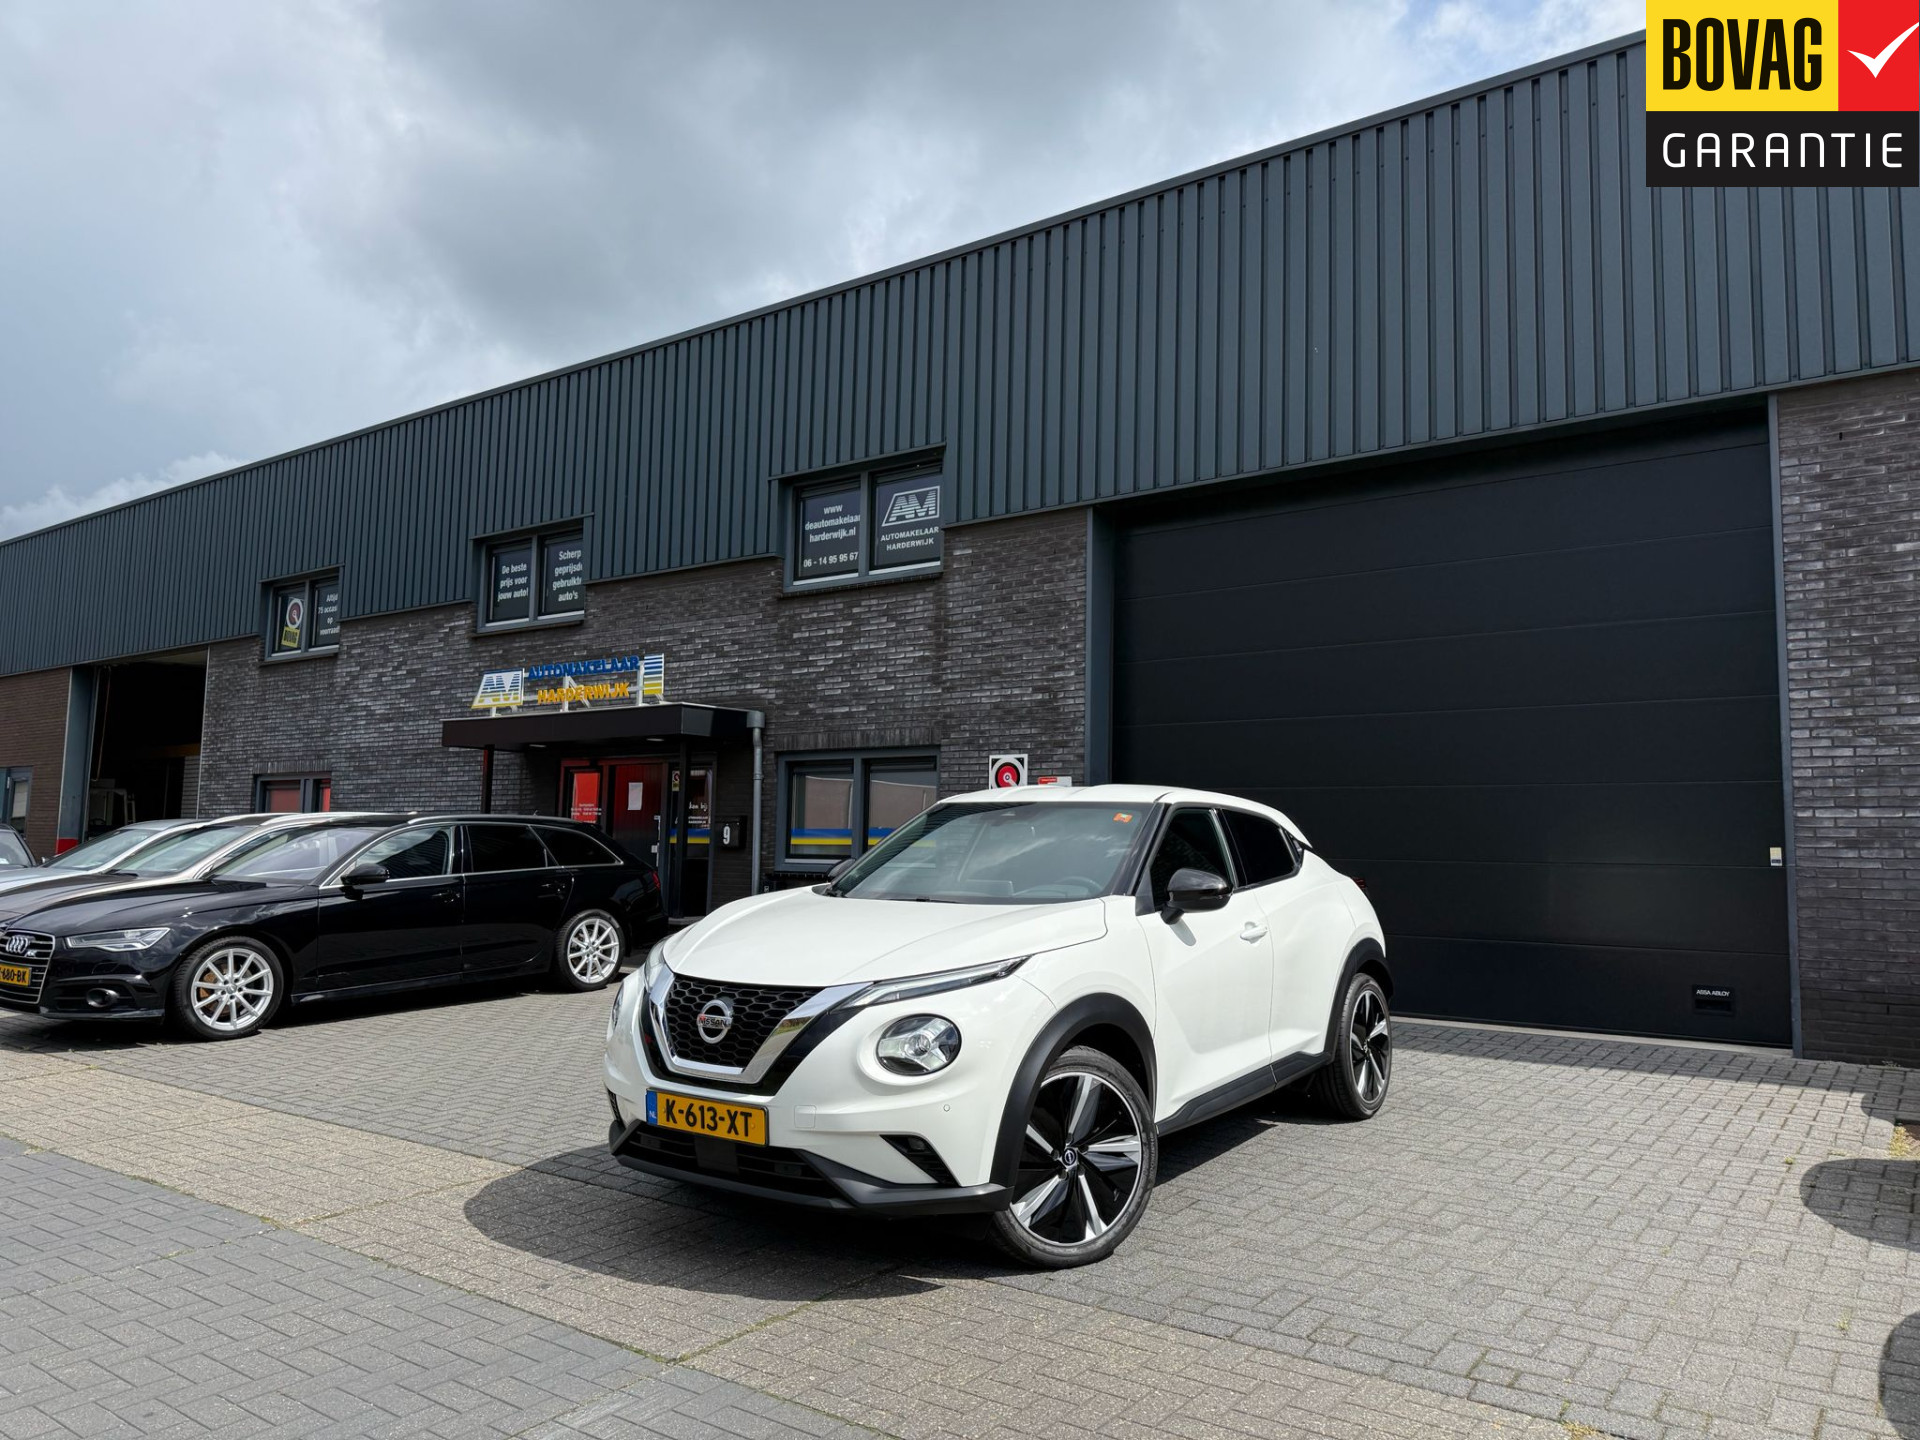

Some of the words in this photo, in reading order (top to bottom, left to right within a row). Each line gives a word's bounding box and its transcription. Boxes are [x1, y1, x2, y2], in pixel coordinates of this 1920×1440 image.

[823, 504, 843, 515] www
[809, 526, 856, 543] harderwijk.nl
[880, 526, 939, 542] AUTOMAKELAAR
[886, 537, 934, 551] HARDERWIJK
[558, 549, 582, 561] Scherp
[803, 559, 812, 568] 06
[819, 557, 827, 566] 14
[828, 555, 838, 565] 95
[839, 553, 848, 563] 95
[849, 552, 859, 561] 67
[501, 565, 510, 575] De
[511, 563, 527, 573] beste
[500, 577, 513, 589] prijs
[514, 576, 528, 585] voor
[497, 591, 512, 602] jouw
[558, 591, 579, 602] auto's
[527, 655, 641, 681] AUTOMAKELAAR
[537, 681, 630, 705] HARDERWIJK
[723, 825, 731, 845] 9
[665, 1098, 752, 1137] K-613-XT
